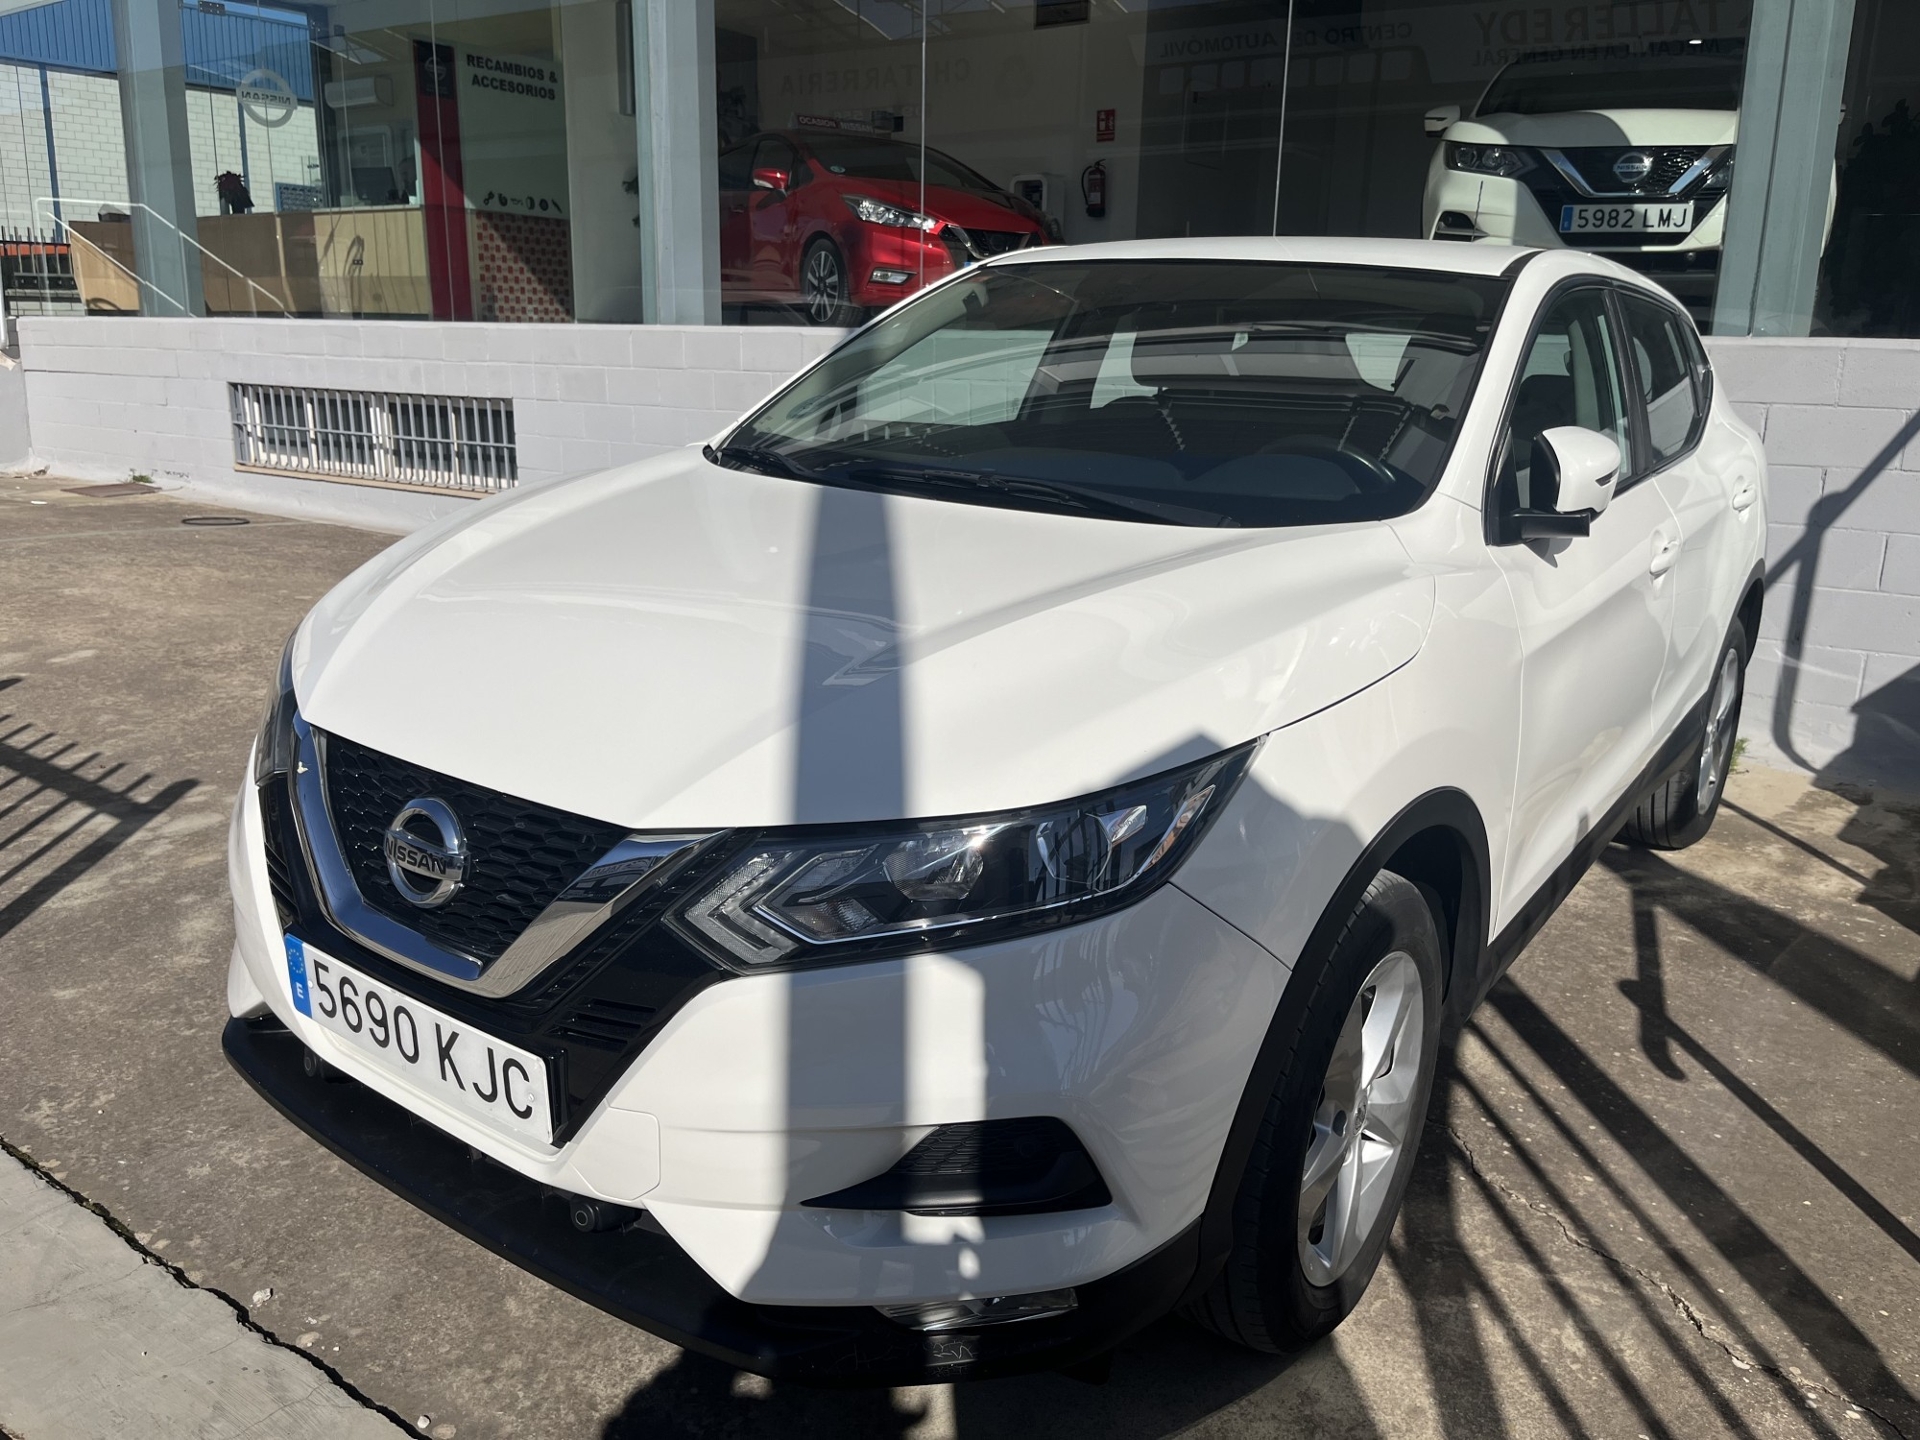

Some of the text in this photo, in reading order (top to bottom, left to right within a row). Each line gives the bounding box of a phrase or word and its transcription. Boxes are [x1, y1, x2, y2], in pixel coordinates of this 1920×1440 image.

[466, 54, 558, 84] RECAMBIOS &
[471, 74, 556, 101] ACCESORIOS
[1577, 207, 1688, 228] 5982 LMJ
[385, 837, 447, 875] NISSAN
[295, 981, 304, 999] E
[314, 958, 533, 1120] 5690 KJC
